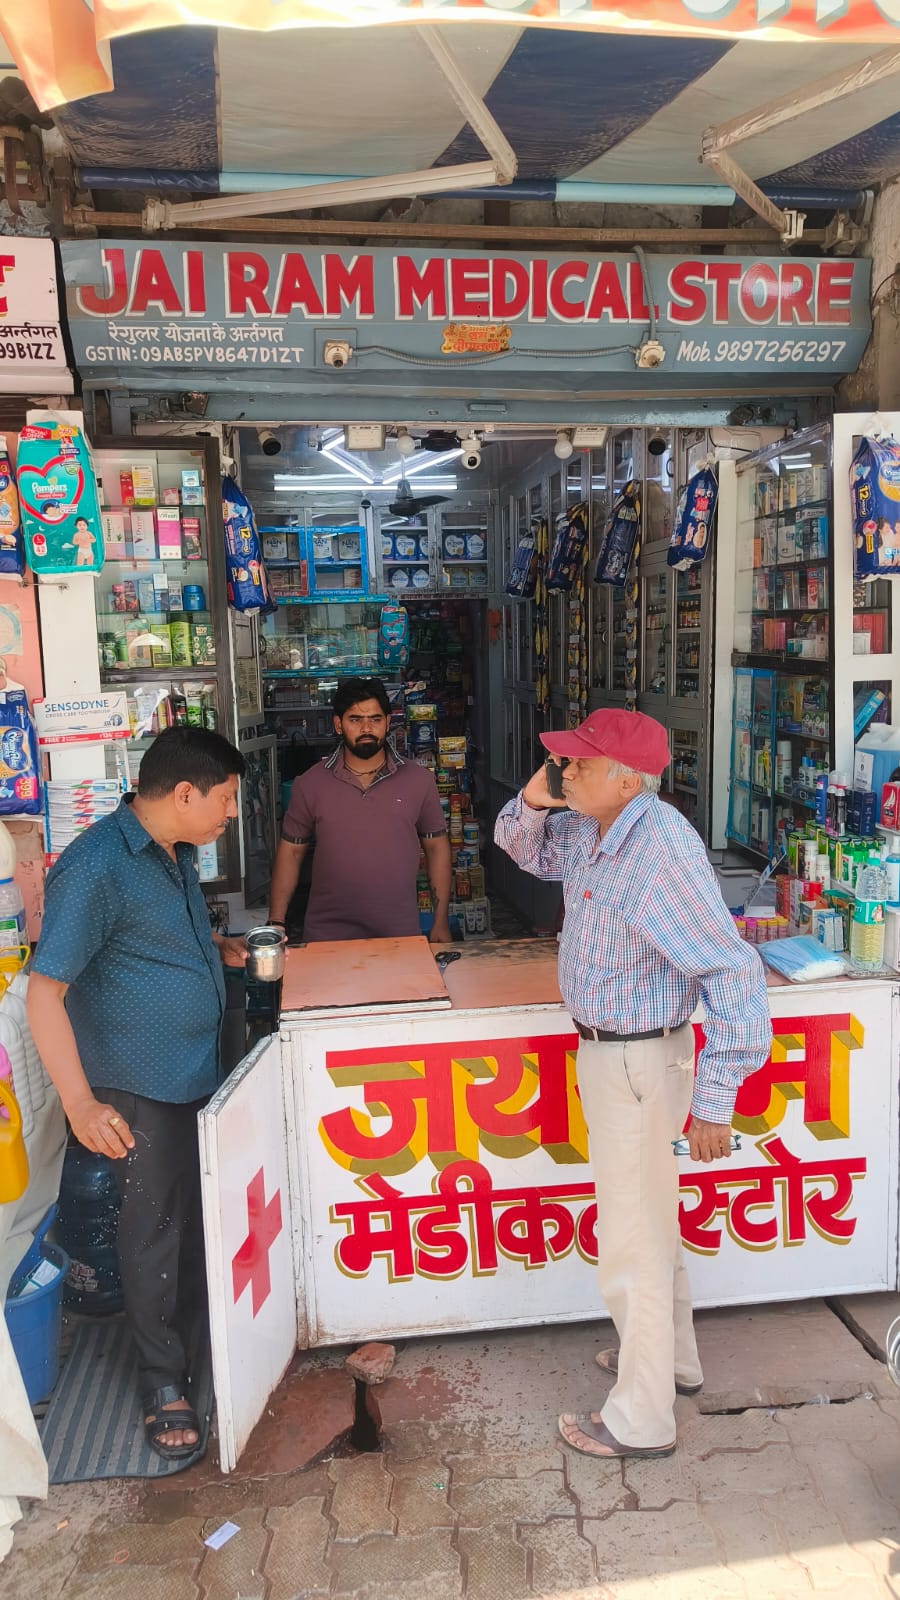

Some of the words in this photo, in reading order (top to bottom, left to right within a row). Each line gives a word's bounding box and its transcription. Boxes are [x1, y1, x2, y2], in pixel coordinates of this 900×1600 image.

[76, 248, 207, 318] JAI
[224, 251, 376, 320] RAM
[395, 255, 660, 324] MEDICAL
[667, 260, 856, 327] STORE
[108, 321, 160, 345] रेगुलर
[163, 322, 211, 342] योजना
[44, 699, 110, 713] SENSODYNE
[19, 778, 33, 799] 399
